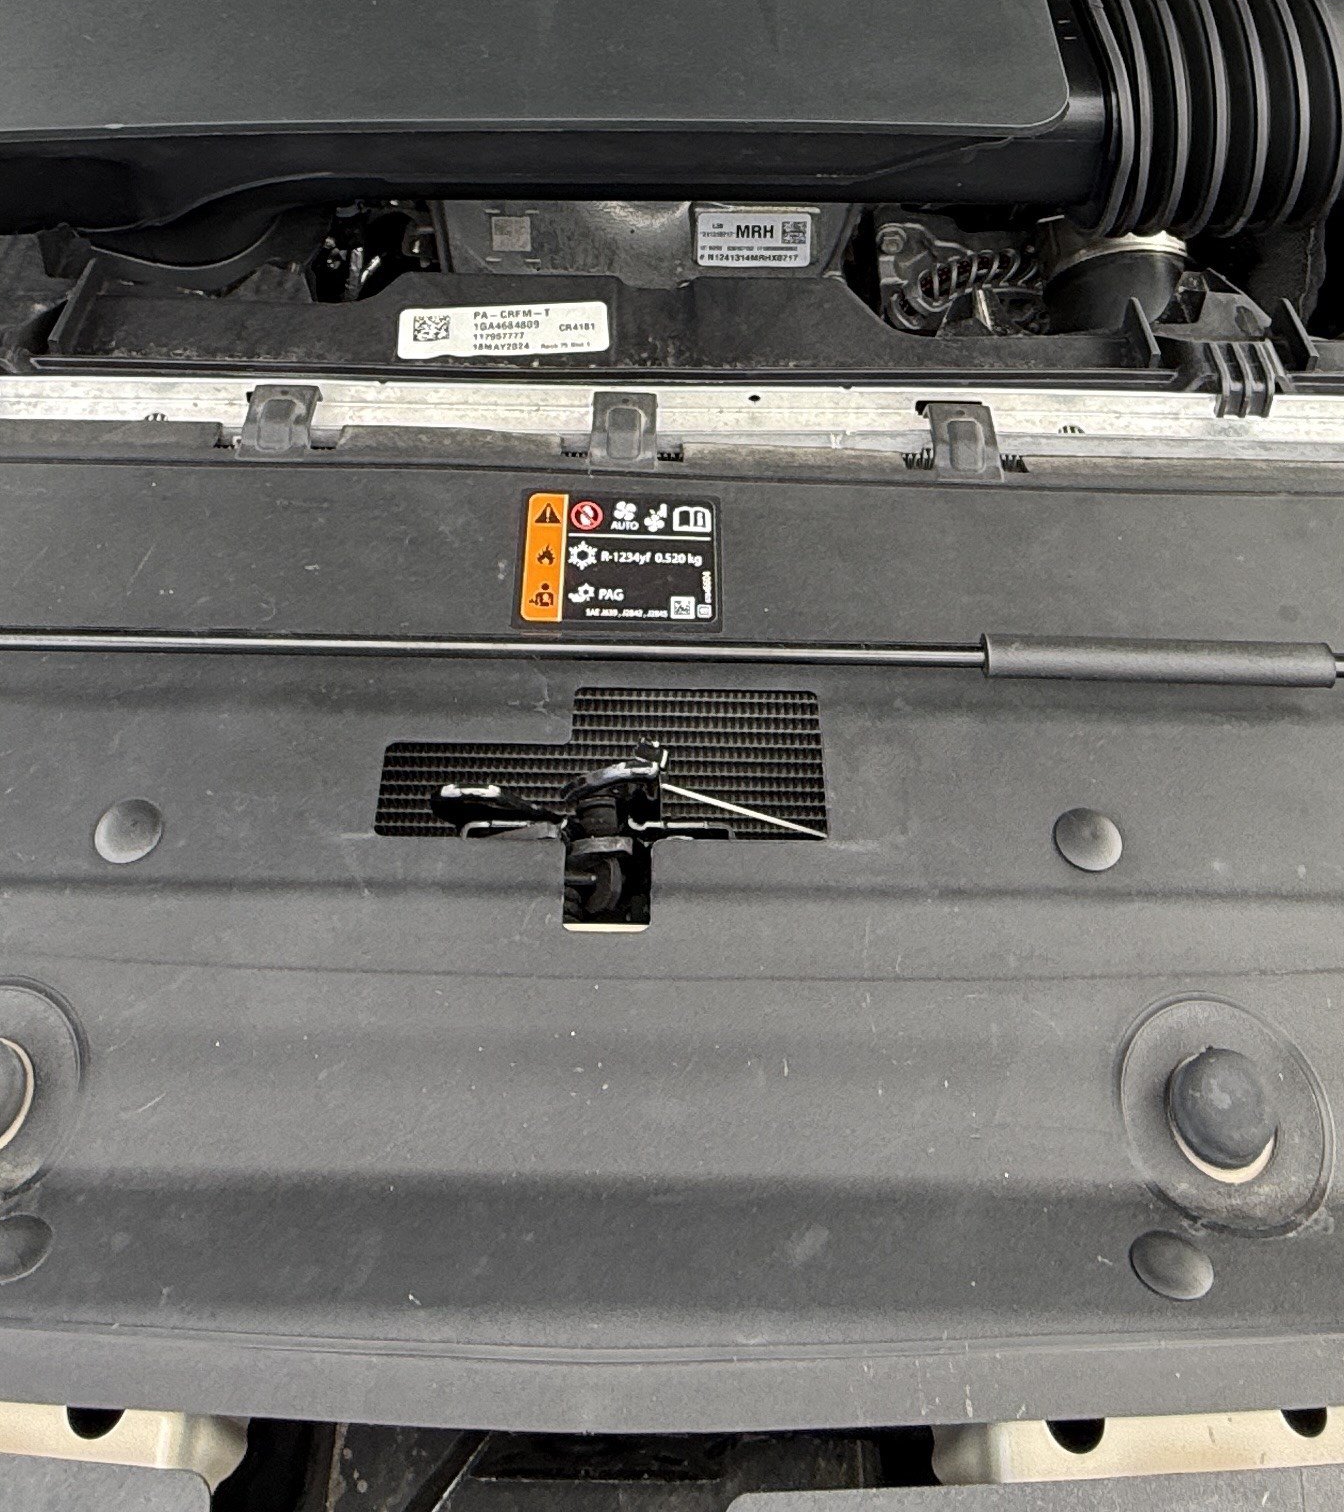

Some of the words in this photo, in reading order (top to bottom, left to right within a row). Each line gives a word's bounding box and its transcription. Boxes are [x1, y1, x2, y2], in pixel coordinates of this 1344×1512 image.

[736, 224, 774, 239] MRH
[610, 521, 639, 530] AUTO
[600, 550, 652, 565] R-1234yf
[655, 552, 686, 564] 0.520
[687, 553, 703, 567] kg
[598, 588, 625, 601] PAG
